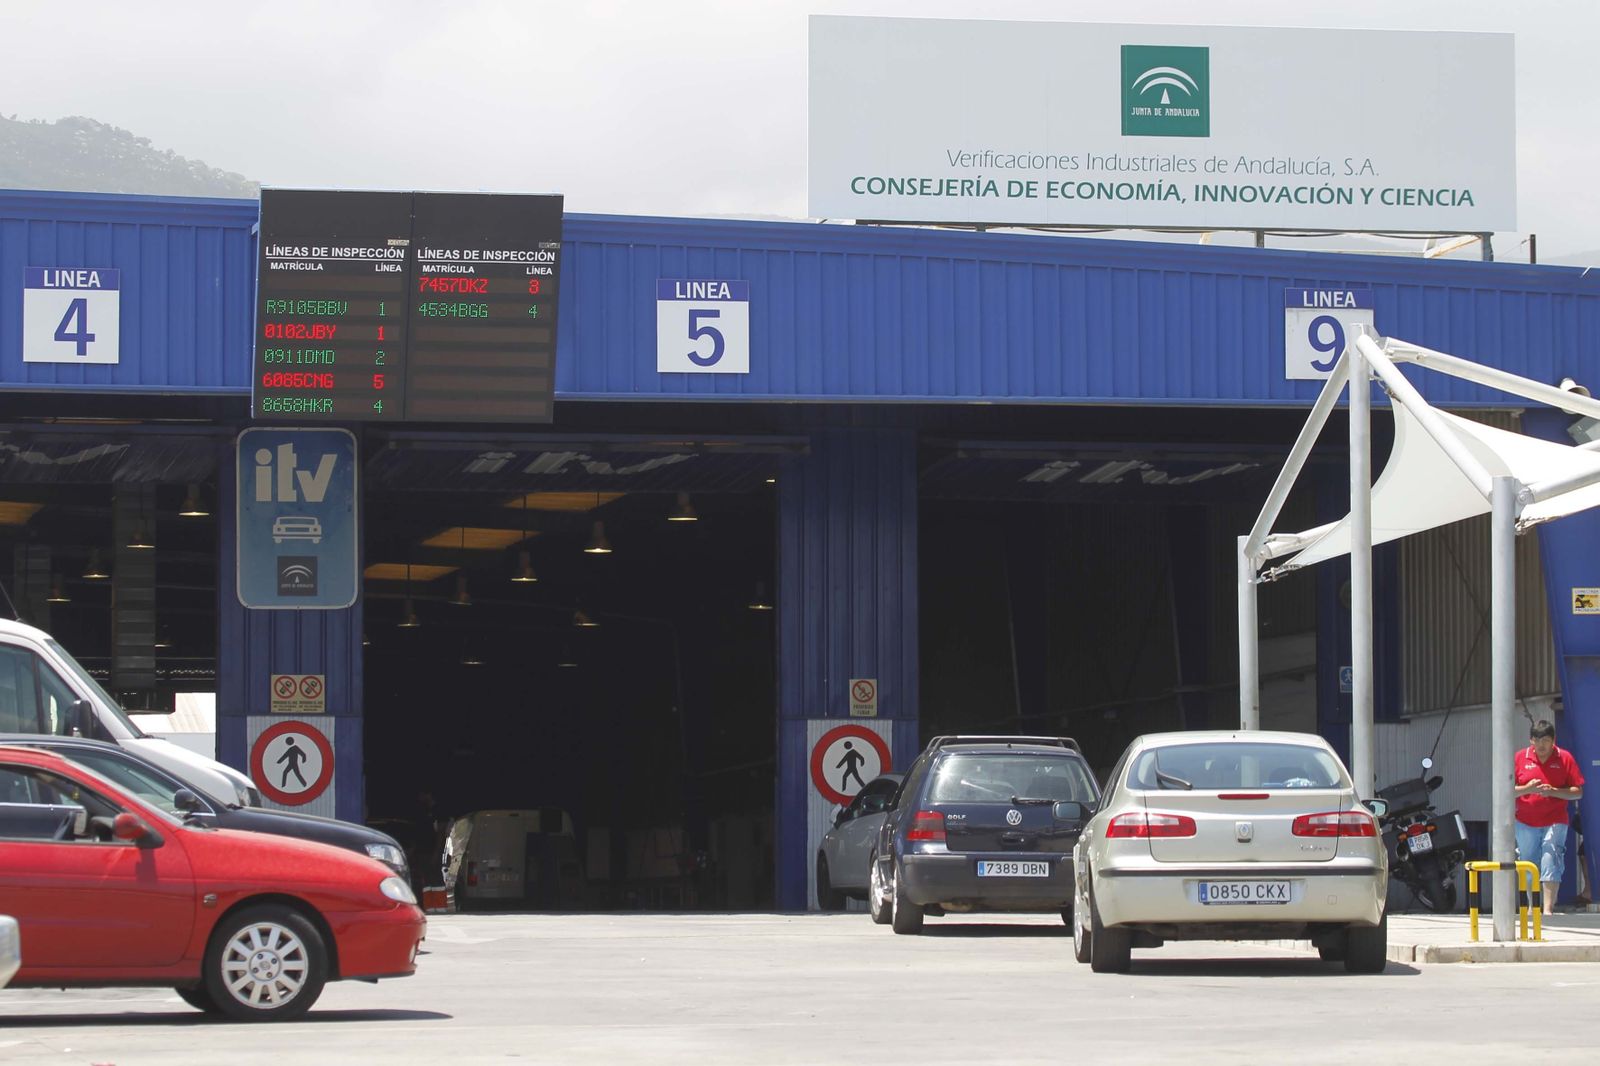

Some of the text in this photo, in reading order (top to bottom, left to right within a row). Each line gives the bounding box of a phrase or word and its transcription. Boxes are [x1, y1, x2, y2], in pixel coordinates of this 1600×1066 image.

[1131, 107, 1152, 116] JUNTA
[1154, 107, 1162, 116] DE
[946, 149, 1380, 177] Verificaciones Industriales de Andalucía, S.A.
[850, 175, 1475, 207] CONSEJERÍA DE ECONOMÍA, INNOVACIÓN Y CIENCIA
[265, 244, 405, 259] LÍNEAS DE INSPECCIÓN
[417, 247, 555, 262] LÍNEAS DE INSPECCIÓN
[270, 260, 402, 273] MATRÍCULA LÍNEA
[422, 264, 553, 276] MATRÍCULA LÍNEA
[43, 269, 101, 288] LINEA
[419, 277, 541, 295] 7457DKZ 3
[675, 281, 731, 299] LINEA
[1303, 290, 1357, 308] LINEA
[266, 299, 386, 317] R9105BBV 1
[418, 302, 538, 319] 4534BGG 4
[54, 298, 95, 356] 4
[264, 323, 385, 341] 0102JBY 1
[687, 309, 725, 367] 5
[1308, 315, 1346, 372] 9
[264, 348, 385, 366] 0911DMD 2
[373, 373, 385, 390] 5
[263, 397, 383, 414] 8658HKR 4
[255, 442, 338, 502] itv
[986, 863, 1047, 875] 7389 DBN
[1210, 884, 1286, 899] 0850 CKX
